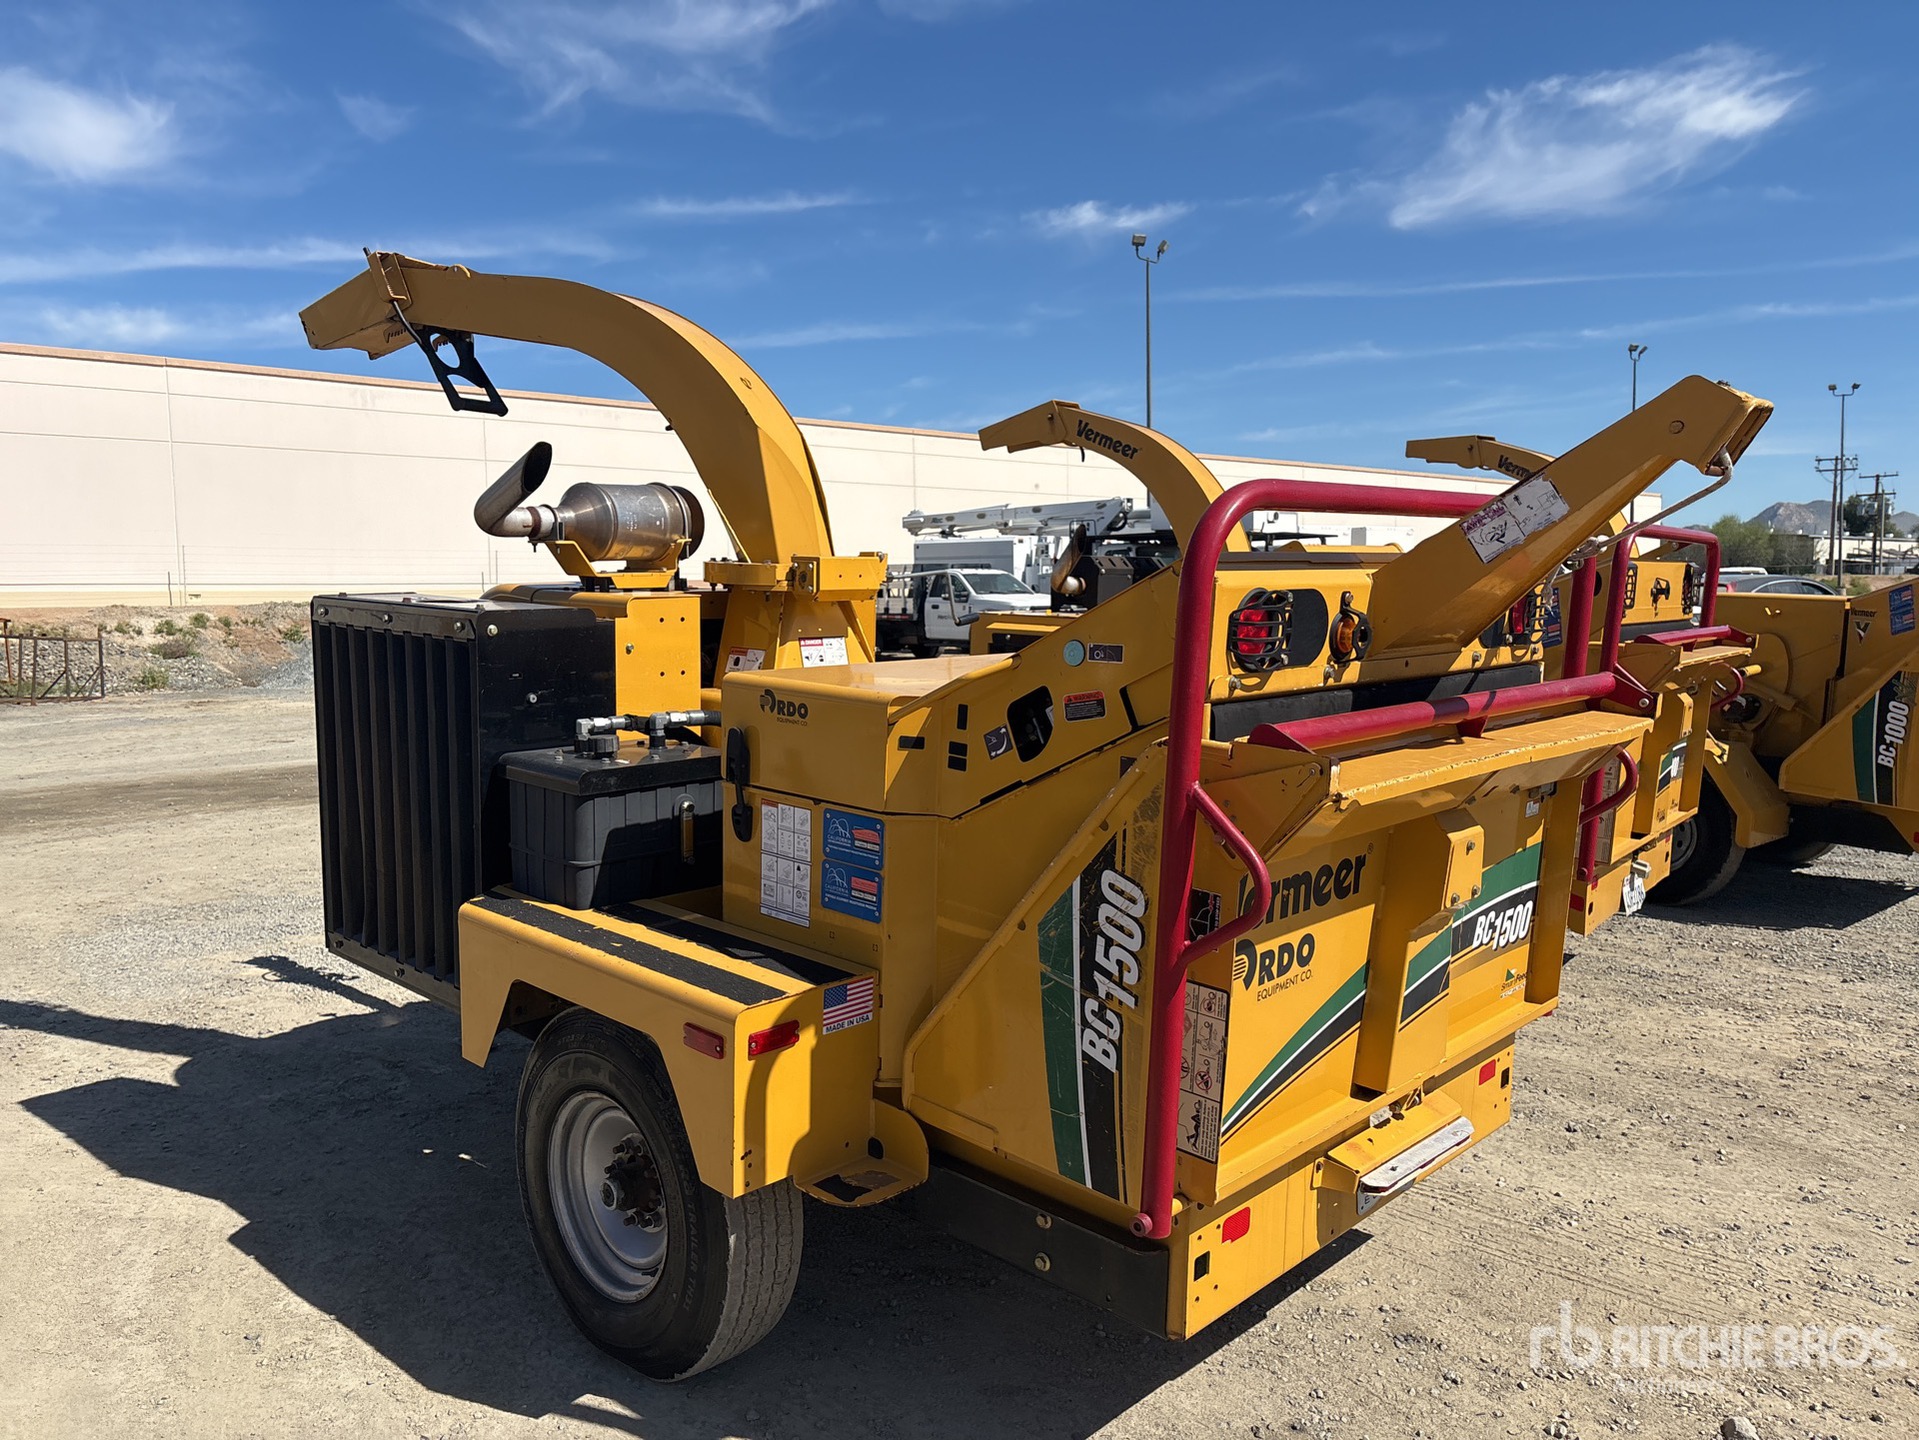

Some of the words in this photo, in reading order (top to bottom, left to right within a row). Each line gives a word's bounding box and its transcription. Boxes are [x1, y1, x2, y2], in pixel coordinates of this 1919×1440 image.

[1077, 419, 1138, 459] Vermeer
[1498, 455, 1532, 478] Verm
[777, 699, 809, 719] RDO
[1877, 700, 1910, 768] BC1000
[1472, 900, 1534, 951] BC1500
[1082, 869, 1147, 1073] BC1500
[1258, 933, 1315, 986] RDO
[1257, 975, 1299, 1001] EQUIPMENT
[825, 1021, 846, 1033] MADE
[847, 1019, 855, 1027] IN
[856, 1014, 870, 1024] USA
